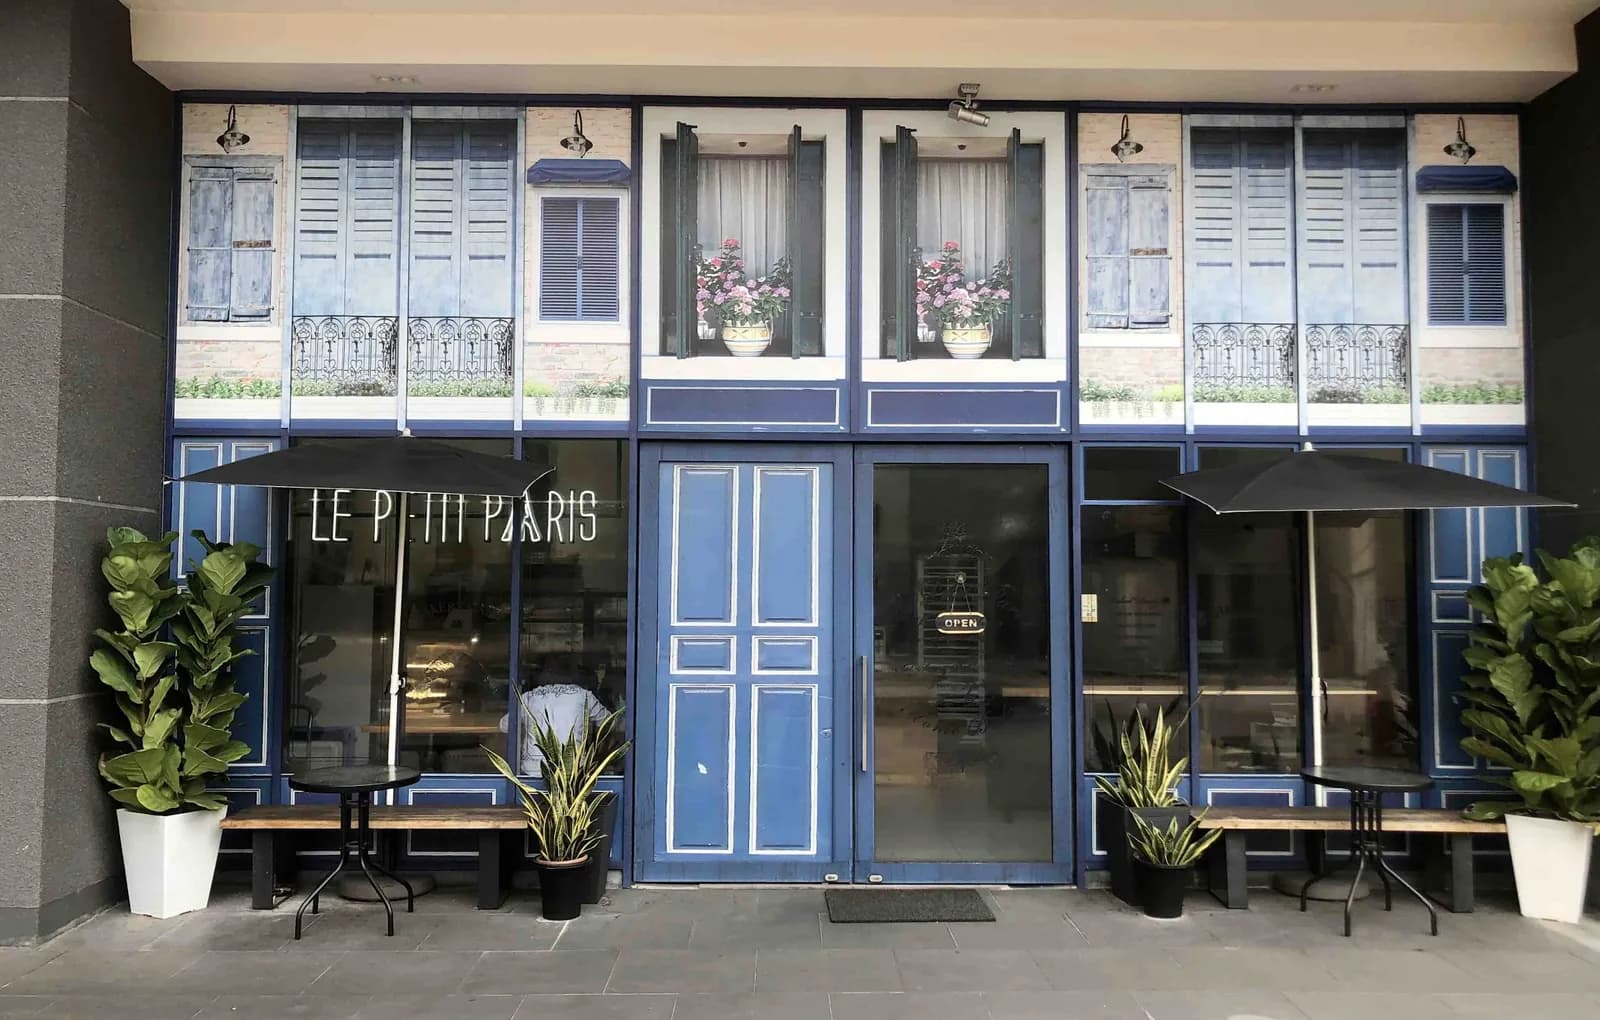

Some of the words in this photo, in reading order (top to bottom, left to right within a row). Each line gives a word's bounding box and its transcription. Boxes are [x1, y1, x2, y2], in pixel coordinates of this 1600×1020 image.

[311, 488, 351, 542] LE
[483, 490, 596, 543] PARIS
[944, 619, 978, 628] OPEN
